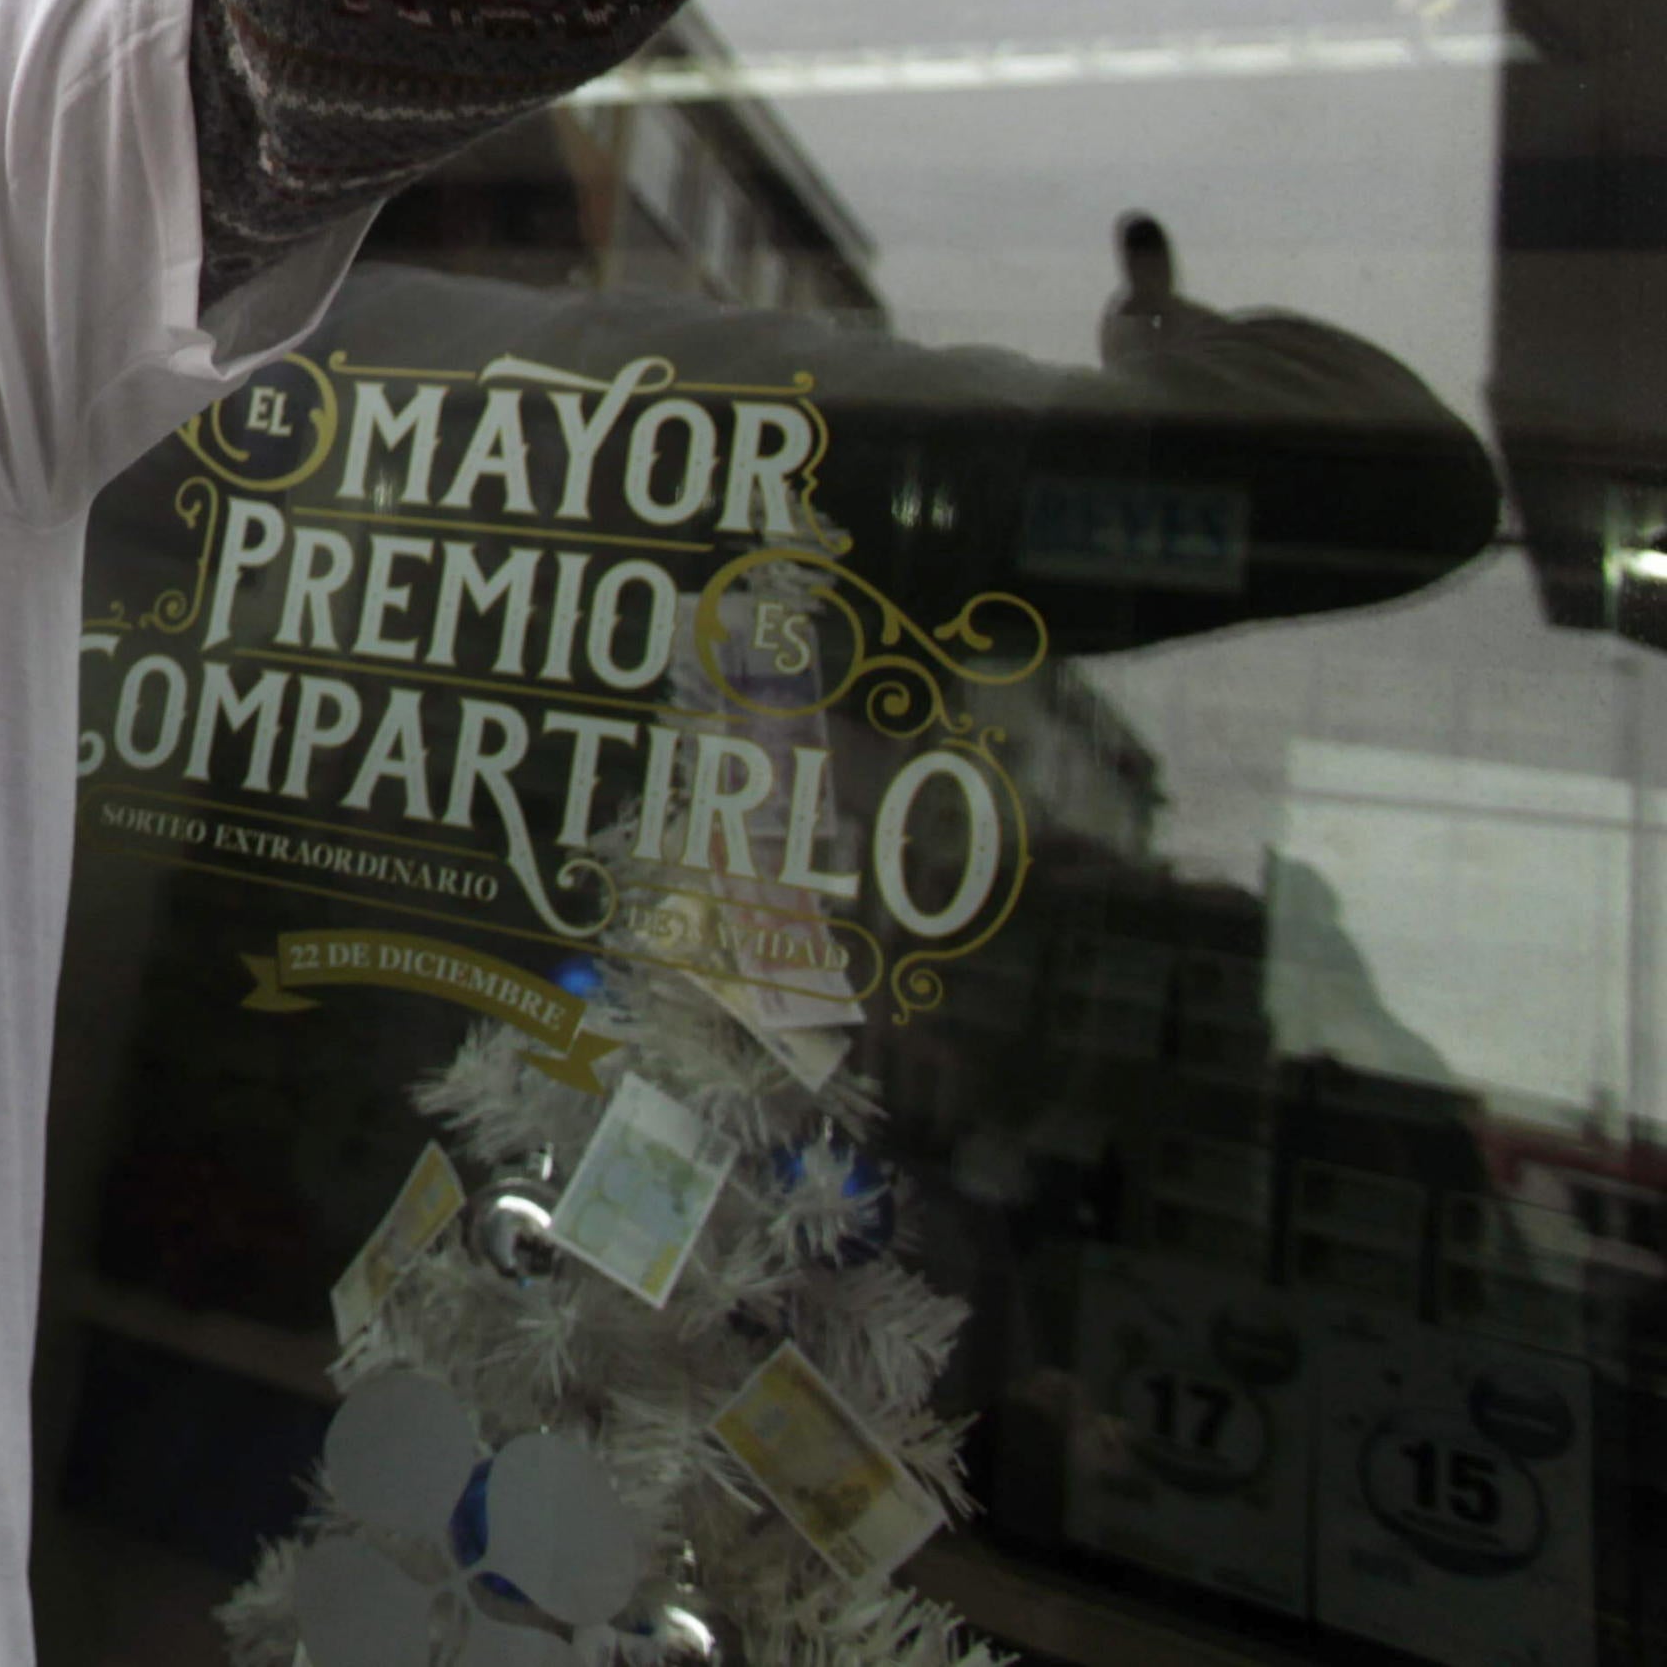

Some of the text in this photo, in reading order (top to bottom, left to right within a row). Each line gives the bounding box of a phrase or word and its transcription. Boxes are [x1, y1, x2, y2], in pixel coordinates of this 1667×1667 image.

[245, 354, 813, 536] EL MAYOR
[203, 494, 812, 691] PREMIO ES
[100, 801, 207, 845] SORTEO
[214, 822, 499, 902] EXTRAORDINARIO
[290, 941, 566, 1031] 22 DE DICIEMBRE
[1401, 1439, 1500, 1527] 15
